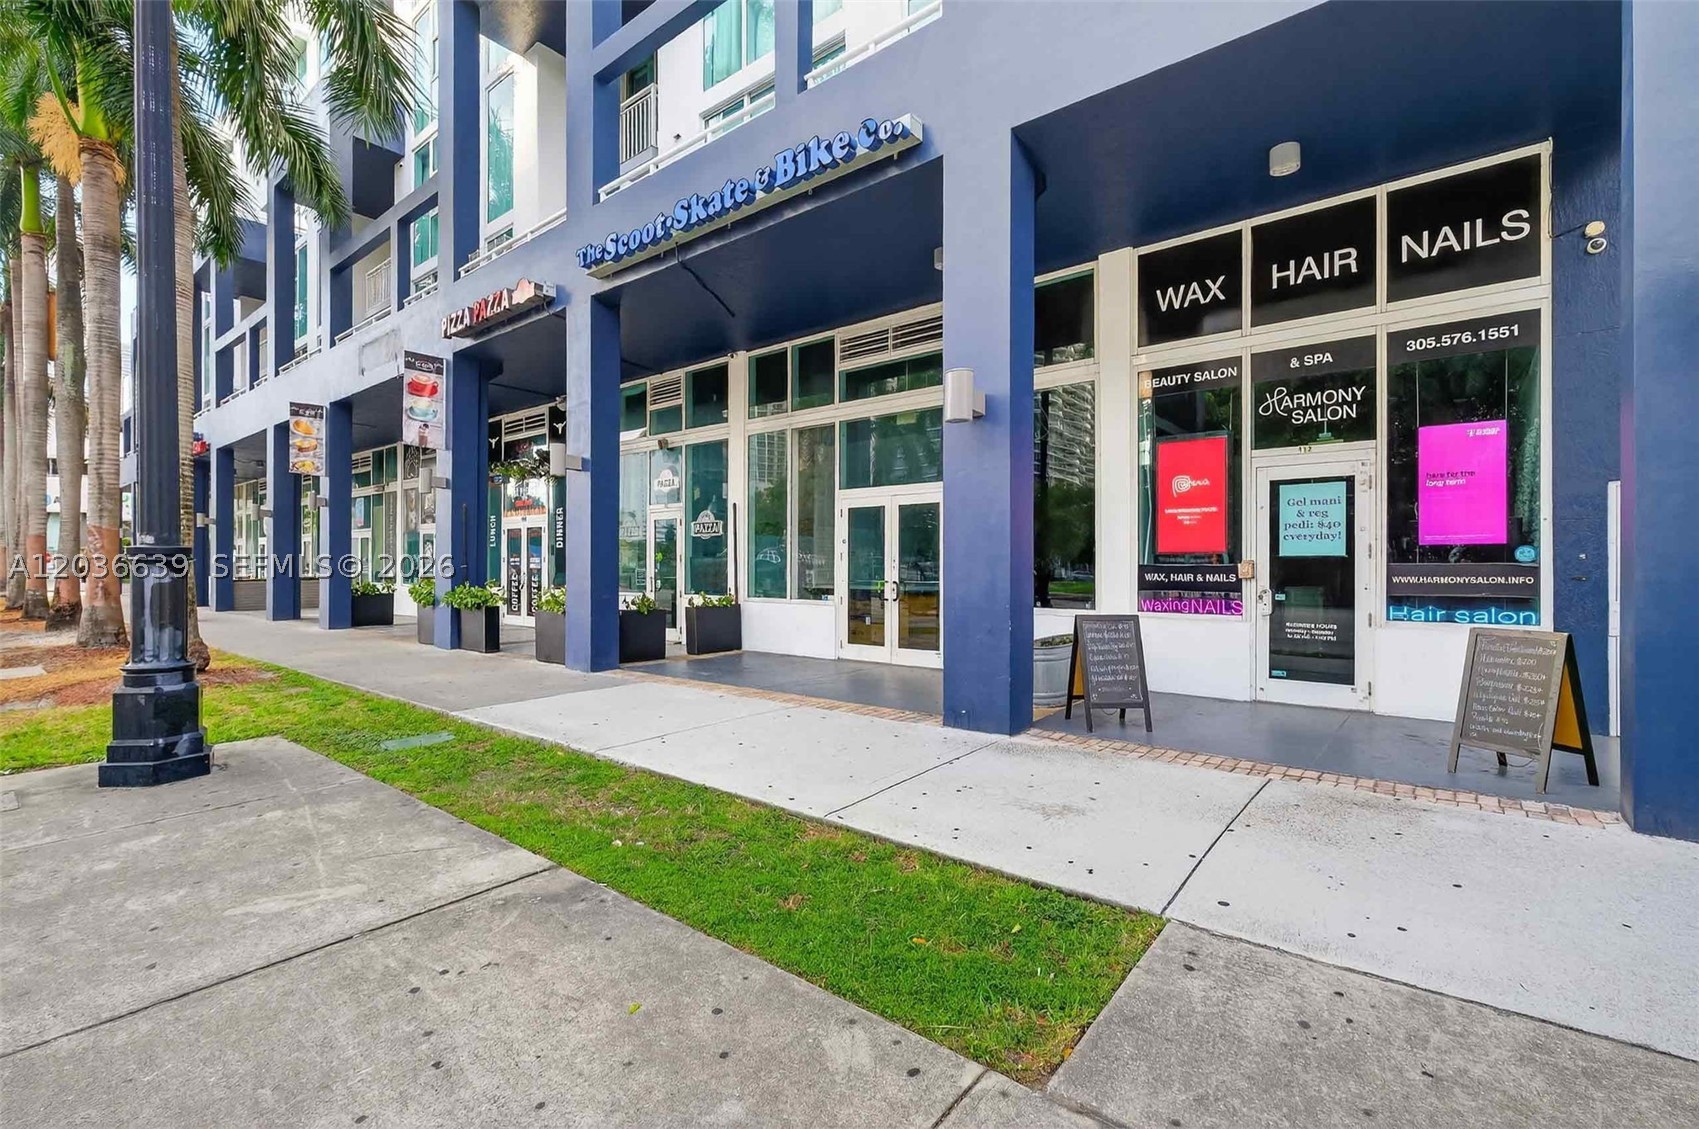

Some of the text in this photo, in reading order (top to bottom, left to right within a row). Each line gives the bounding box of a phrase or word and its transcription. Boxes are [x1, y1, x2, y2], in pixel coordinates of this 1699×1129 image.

[576, 243, 604, 268] The
[755, 166, 773, 190] &
[774, 131, 853, 187] Bike
[858, 118, 908, 151] Co.
[1156, 208, 1531, 313] WAX HAIR NAILS
[441, 288, 510, 338] PIZZA PAZZA
[1406, 323, 1520, 352] 305.576.1551
[1144, 352, 1333, 390] BEAUTY SALON & SPA
[1258, 386, 1366, 417] HARMONY
[1291, 404, 1358, 425] SALON
[1287, 496, 1341, 507] Gel mani
[1296, 510, 1329, 518] & reg
[1284, 520, 1314, 531] pedi:
[1283, 531, 1342, 542] everyday!
[1144, 573, 1236, 582] WAX, HAIR & NAILS
[1392, 576, 1535, 585] WWW.HARMONYSALON.INFO
[1191, 599, 1244, 615] NAILS
[1389, 605, 1536, 624] Hair salon
